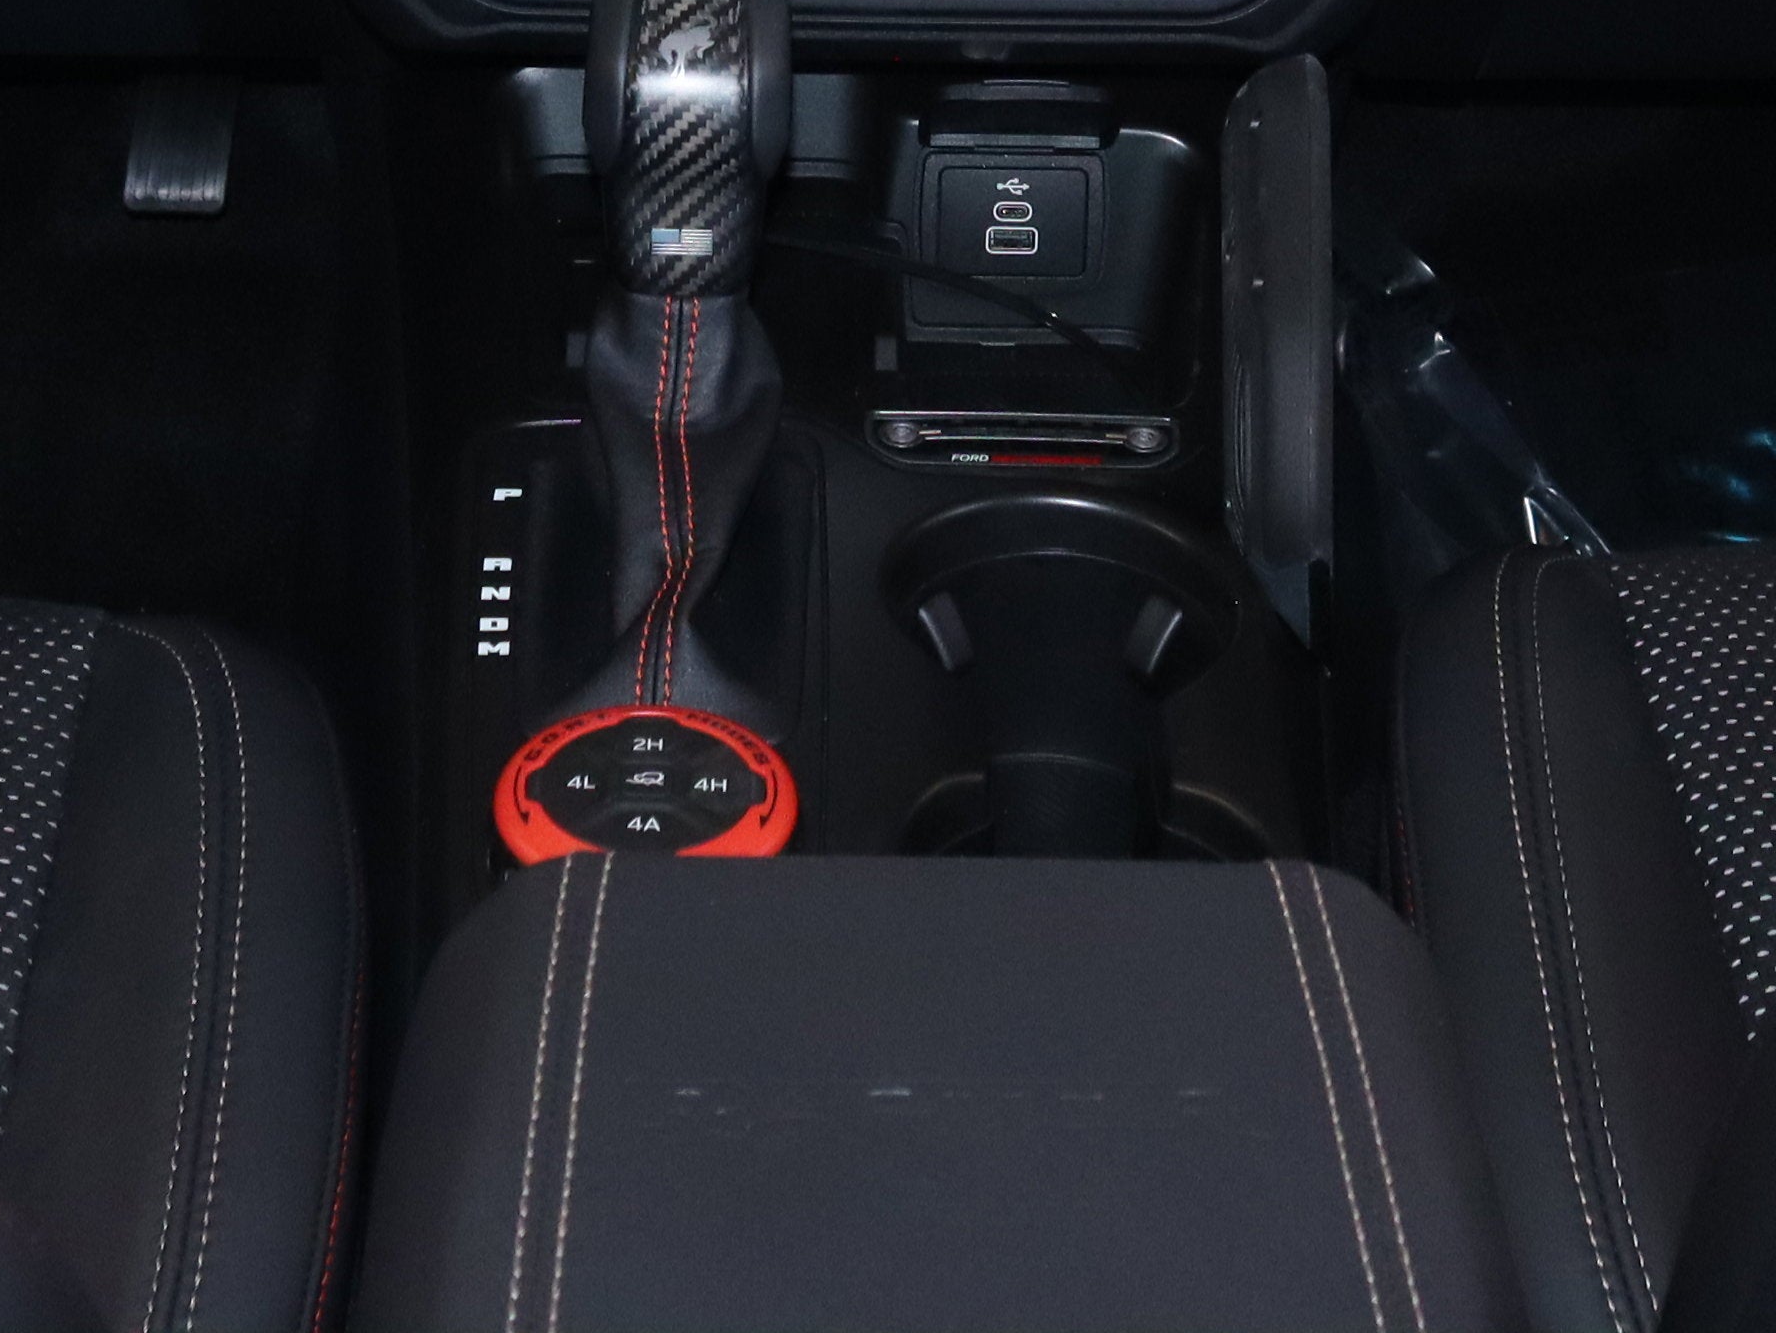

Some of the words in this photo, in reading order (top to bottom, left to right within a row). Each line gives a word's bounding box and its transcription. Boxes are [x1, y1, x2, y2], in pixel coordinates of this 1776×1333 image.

[951, 453, 989, 462] FORD
[493, 488, 523, 501] P
[483, 557, 513, 572] R
[481, 586, 511, 601] N
[479, 617, 509, 632] D
[477, 641, 510, 656] M
[632, 737, 664, 752] 2H
[566, 774, 596, 790] 4L
[693, 777, 728, 793] 4H
[627, 816, 661, 832] 4A
